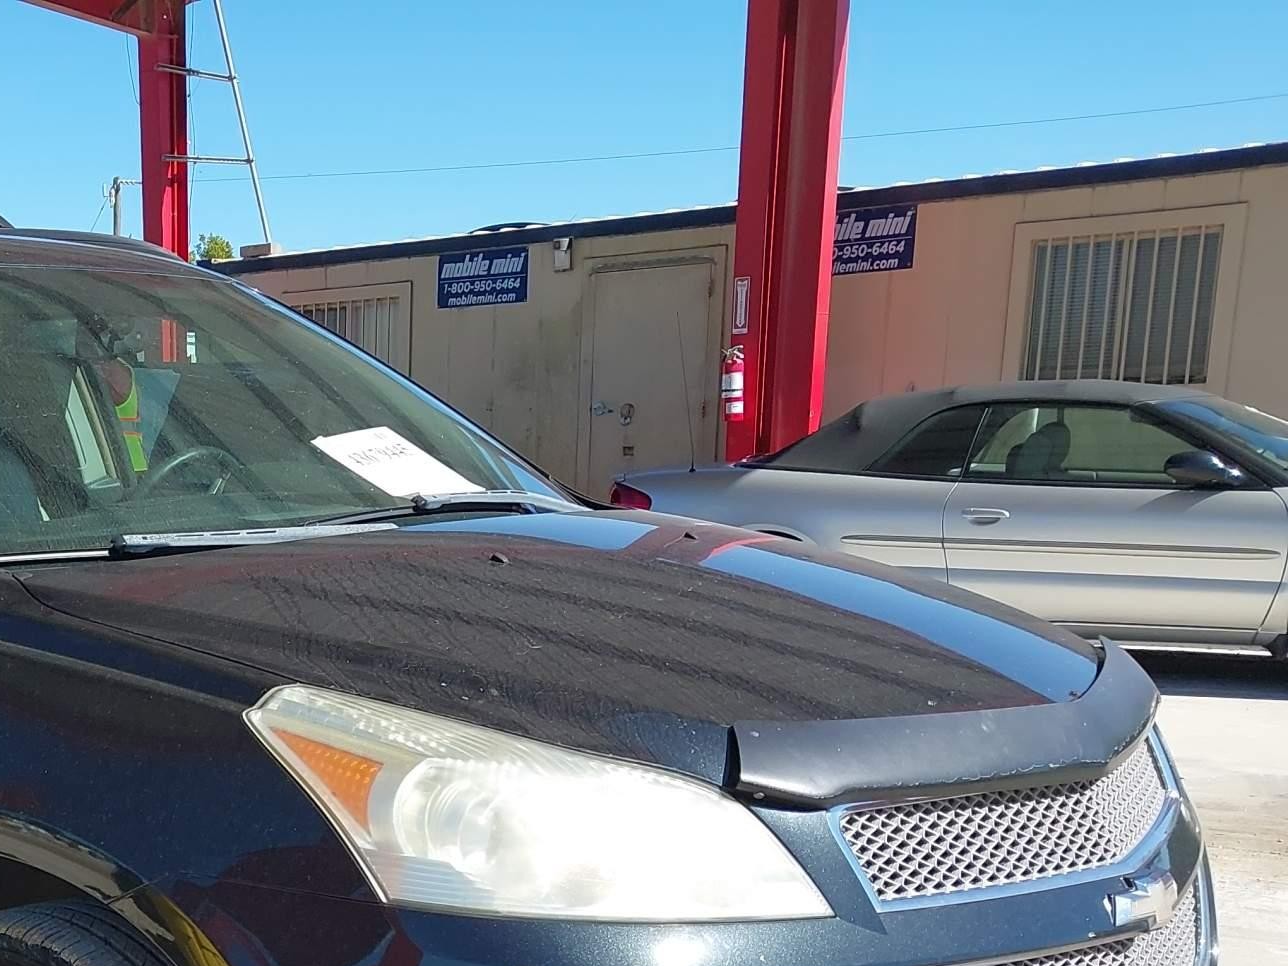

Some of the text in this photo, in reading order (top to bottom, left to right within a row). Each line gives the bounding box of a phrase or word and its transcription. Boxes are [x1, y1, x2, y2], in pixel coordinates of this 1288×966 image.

[865, 211, 912, 238] mini
[832, 240, 906, 260] 0-950-6464
[440, 252, 526, 279] mobile mini
[832, 258, 899, 275] ilemini.com
[444, 277, 521, 294] 1-800-950-6464
[447, 292, 517, 306] mobilemini.com
